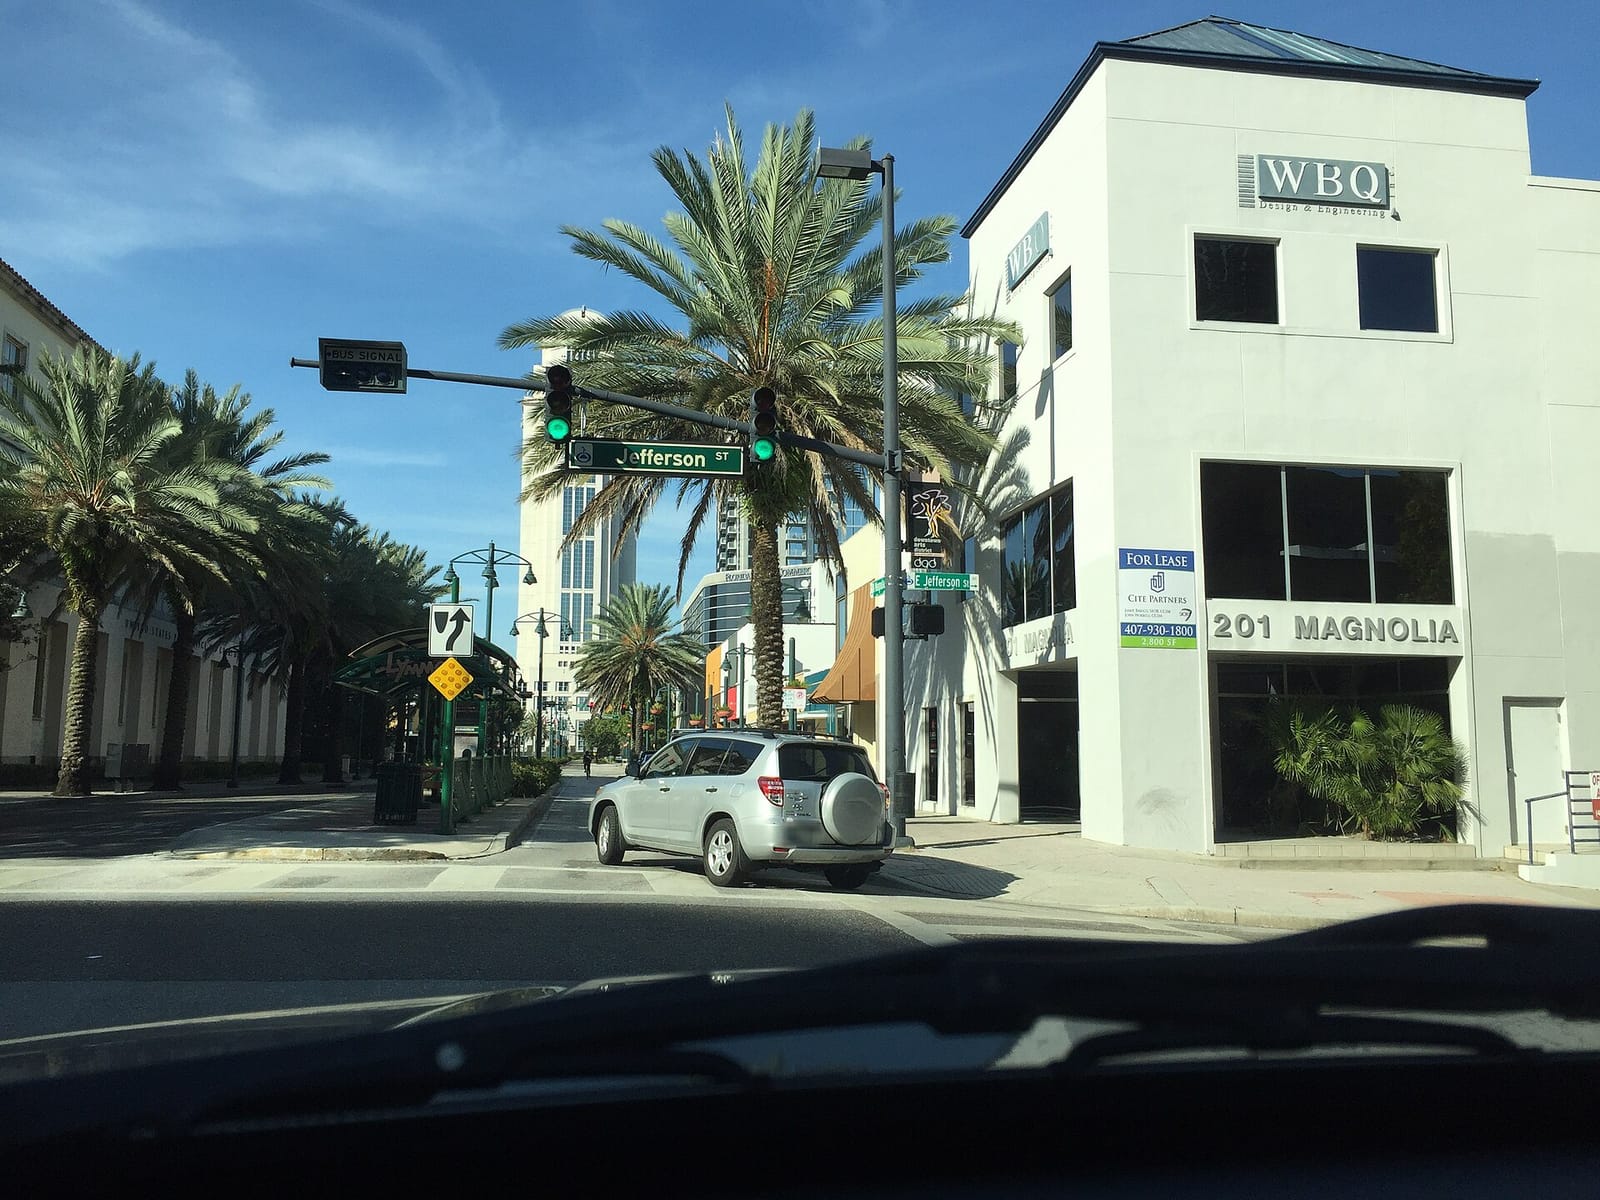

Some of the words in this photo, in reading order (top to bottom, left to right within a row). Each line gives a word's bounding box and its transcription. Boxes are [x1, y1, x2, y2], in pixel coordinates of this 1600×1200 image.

[1262, 158, 1383, 203] WBQ
[1259, 202, 1298, 212] Design
[1303, 204, 1312, 212] &
[1317, 204, 1386, 219] Engineering
[332, 350, 354, 360] BUS
[359, 351, 403, 362] SIGNAL
[616, 447, 706, 467] Jefferson
[715, 451, 729, 461] ST
[1126, 552, 1152, 565] FOR
[1154, 553, 1188, 567] LEASE
[915, 574, 921, 587] E
[922, 575, 960, 588] Jefferson
[1127, 594, 1147, 603] CITE
[1149, 595, 1188, 605] PARTNERS
[1124, 624, 1194, 637] 407-930-1800
[1213, 613, 1271, 639] 201
[1294, 615, 1460, 644] MAGNOLIA
[1142, 638, 1164, 646] 2,800
